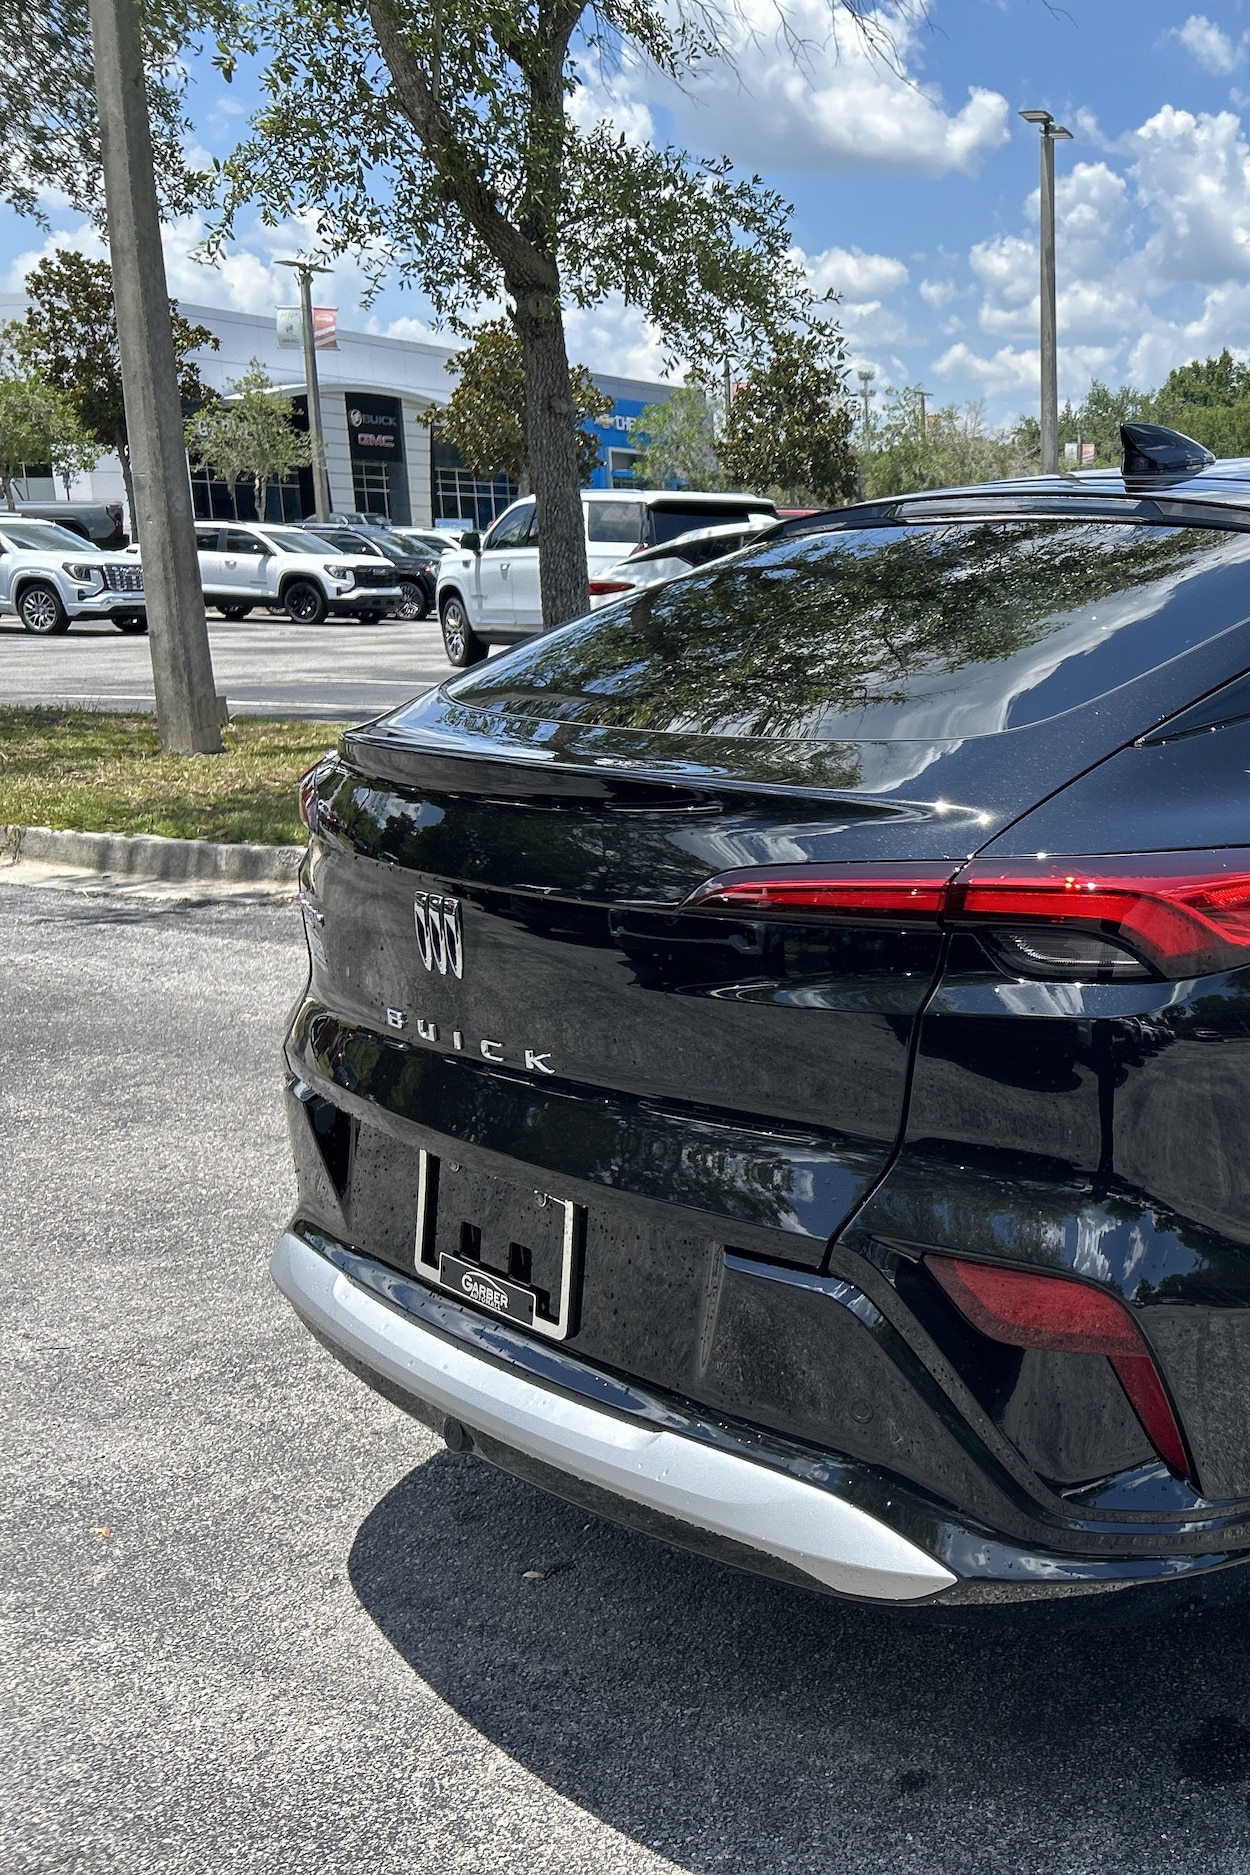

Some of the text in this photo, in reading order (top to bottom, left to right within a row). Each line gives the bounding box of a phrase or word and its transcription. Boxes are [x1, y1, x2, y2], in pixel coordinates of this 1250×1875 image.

[362, 413, 397, 426] BUICK
[358, 432, 395, 447] GMC
[386, 1007, 556, 1075] BUICK
[461, 1273, 509, 1309] GARBER
